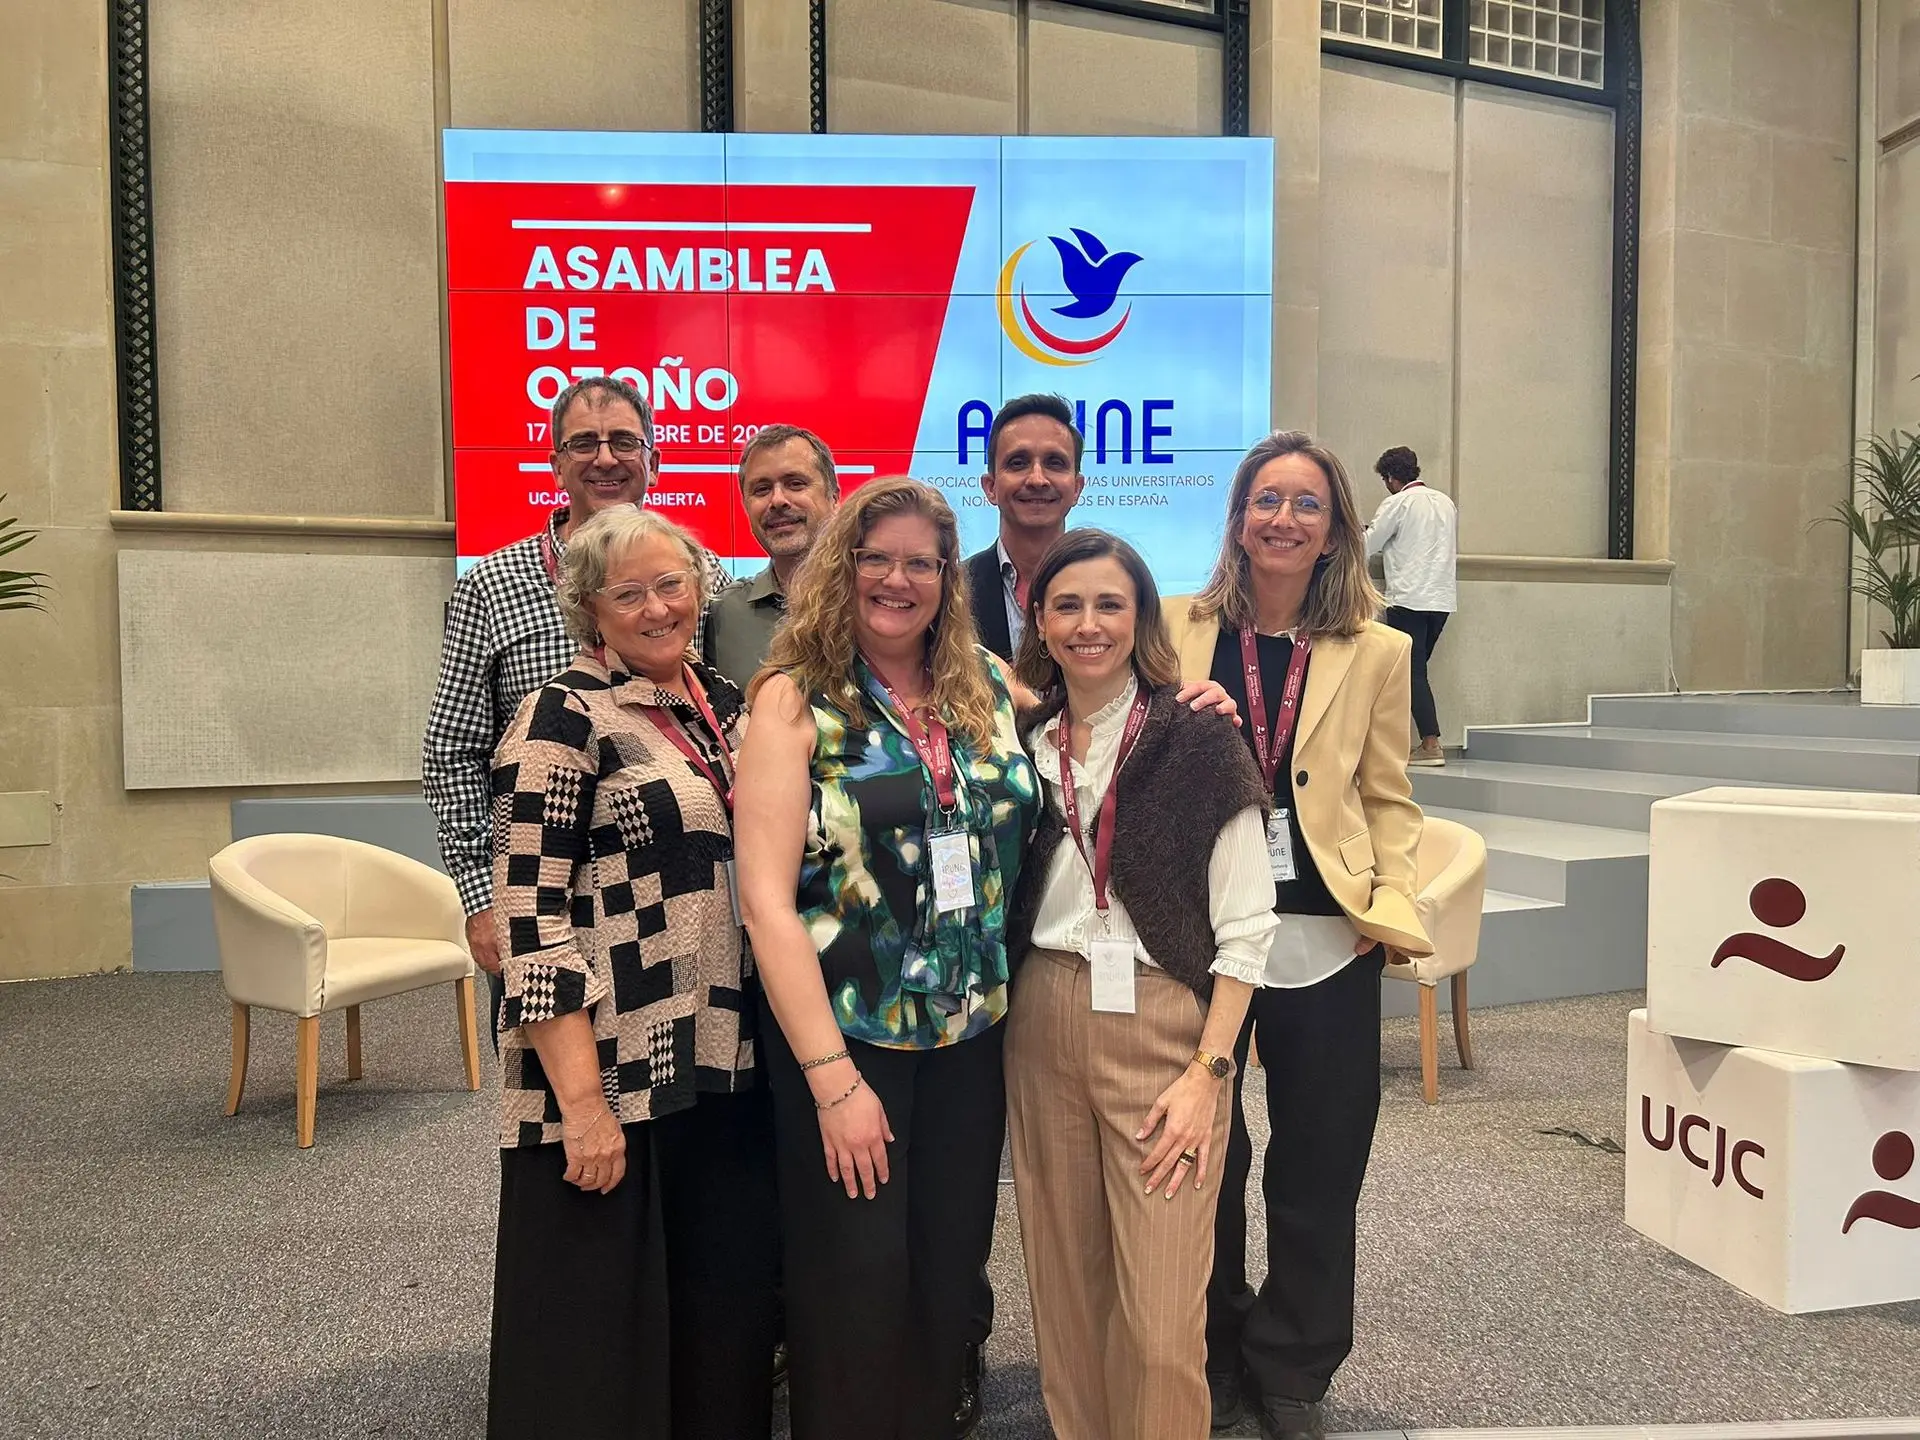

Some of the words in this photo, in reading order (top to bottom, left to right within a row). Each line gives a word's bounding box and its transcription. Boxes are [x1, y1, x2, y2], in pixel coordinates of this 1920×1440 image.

[523, 246, 835, 292] ASAMBLEA
[525, 307, 596, 350] DE
[527, 423, 547, 442] 17
[698, 425, 725, 443] DE
[733, 425, 769, 443] 20
[958, 399, 1174, 464] ANE
[921, 476, 980, 488] SOCIACI
[1112, 475, 1214, 487] UNIVERSITARIOS
[528, 491, 570, 505] UCJC
[643, 492, 706, 506] ABIERTA
[1097, 495, 1115, 506] EN
[1119, 493, 1169, 506] ESPAÑA
[1641, 1094, 1765, 1200] UCJC
